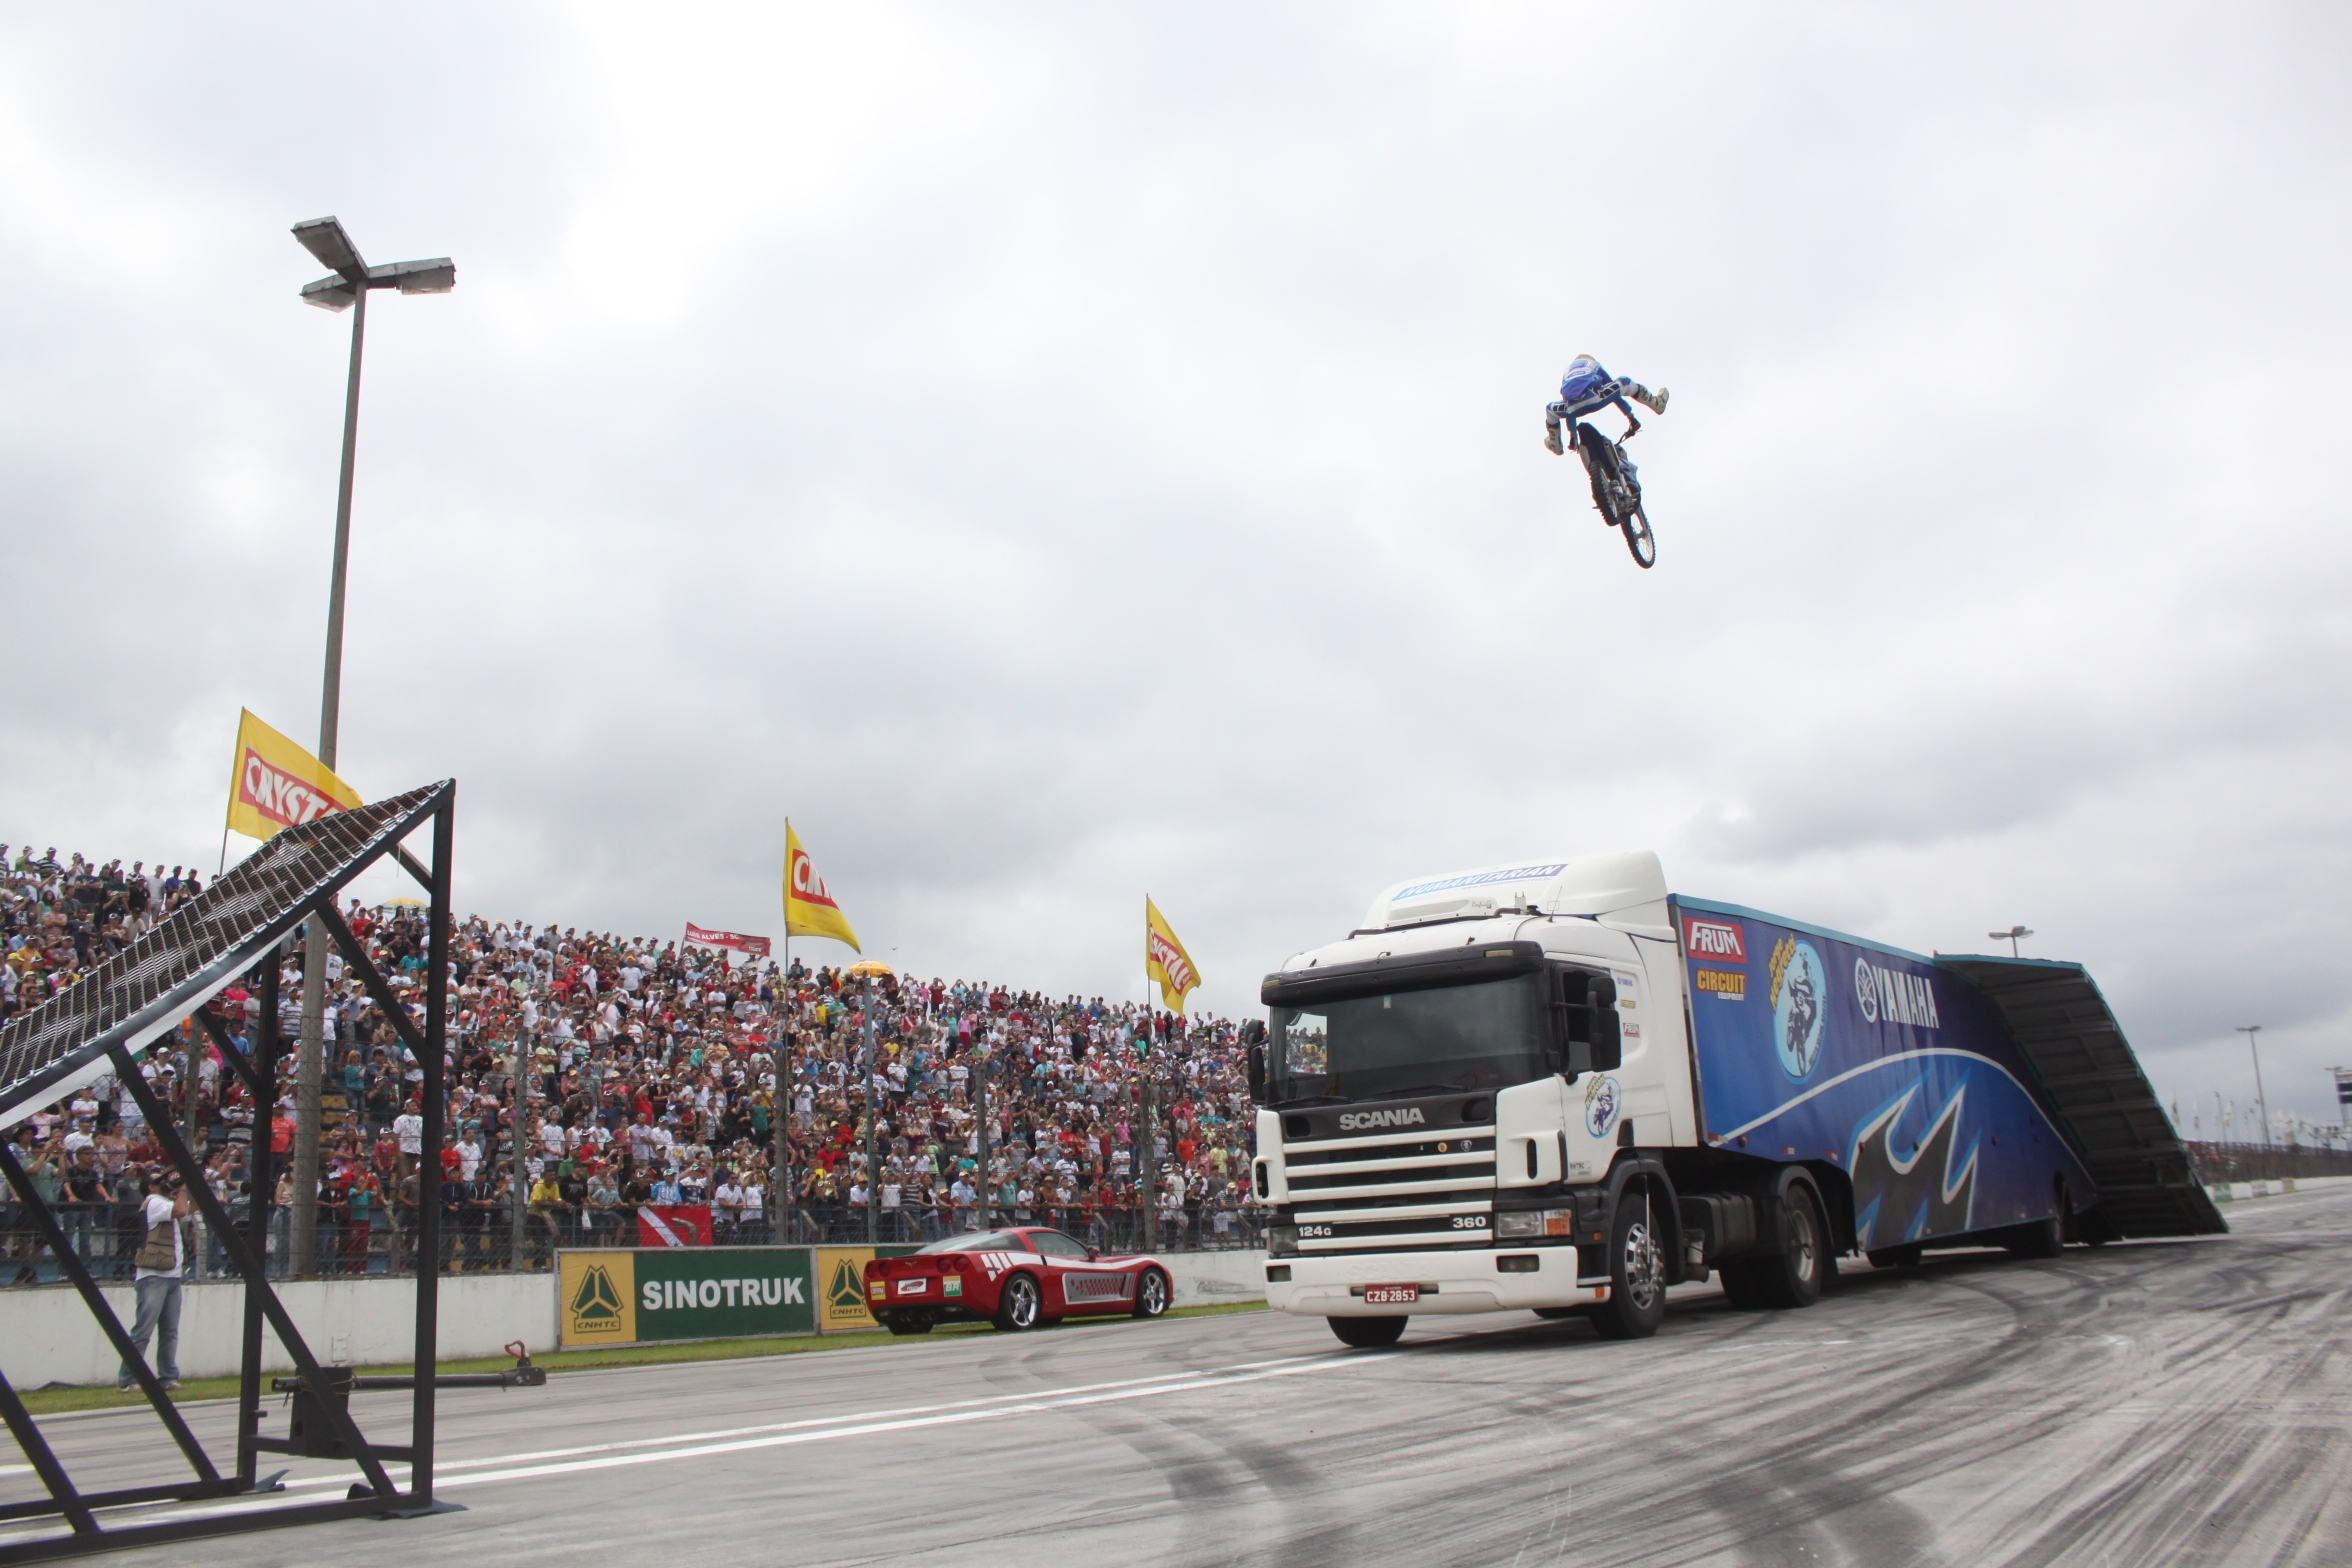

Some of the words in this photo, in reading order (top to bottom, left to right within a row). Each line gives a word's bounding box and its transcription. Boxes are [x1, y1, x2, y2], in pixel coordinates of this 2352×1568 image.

[1400, 865, 1562, 898] HUMANITARIAN
[1690, 921, 1742, 956] FRUM
[1697, 969, 1745, 993] CIRCUIT
[1872, 965, 1940, 1029] YAMAHA
[1339, 1107, 1425, 1130] SCANIA
[1453, 1216, 1486, 1229] 360
[642, 1277, 804, 1310] SINOTRUK
[945, 1283, 960, 1292] BR
[832, 1307, 864, 1316] CNHTC
[577, 1320, 618, 1330] CNHTC
